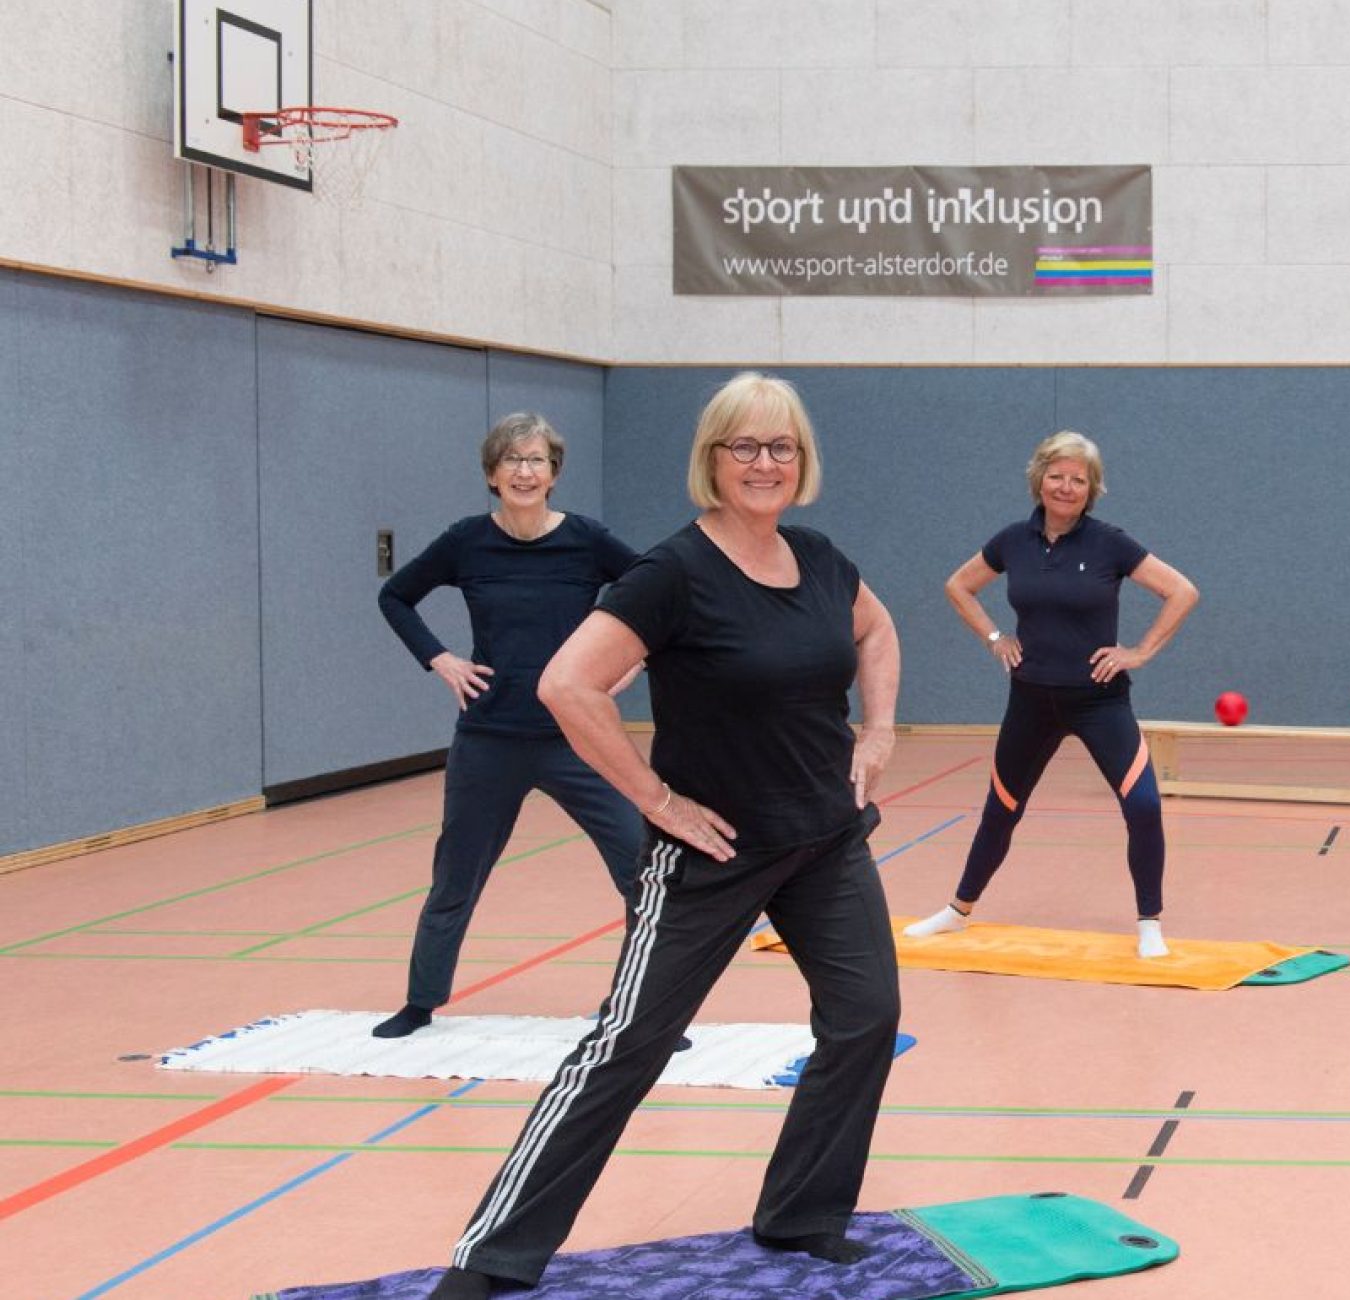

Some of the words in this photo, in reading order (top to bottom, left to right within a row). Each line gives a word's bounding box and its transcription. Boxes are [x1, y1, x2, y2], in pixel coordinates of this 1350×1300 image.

[723, 188, 825, 233] sport
[838, 188, 912, 233] und
[927, 188, 1103, 233] inklusion
[723, 251, 1008, 281] www.sport-alsterdorf.de
